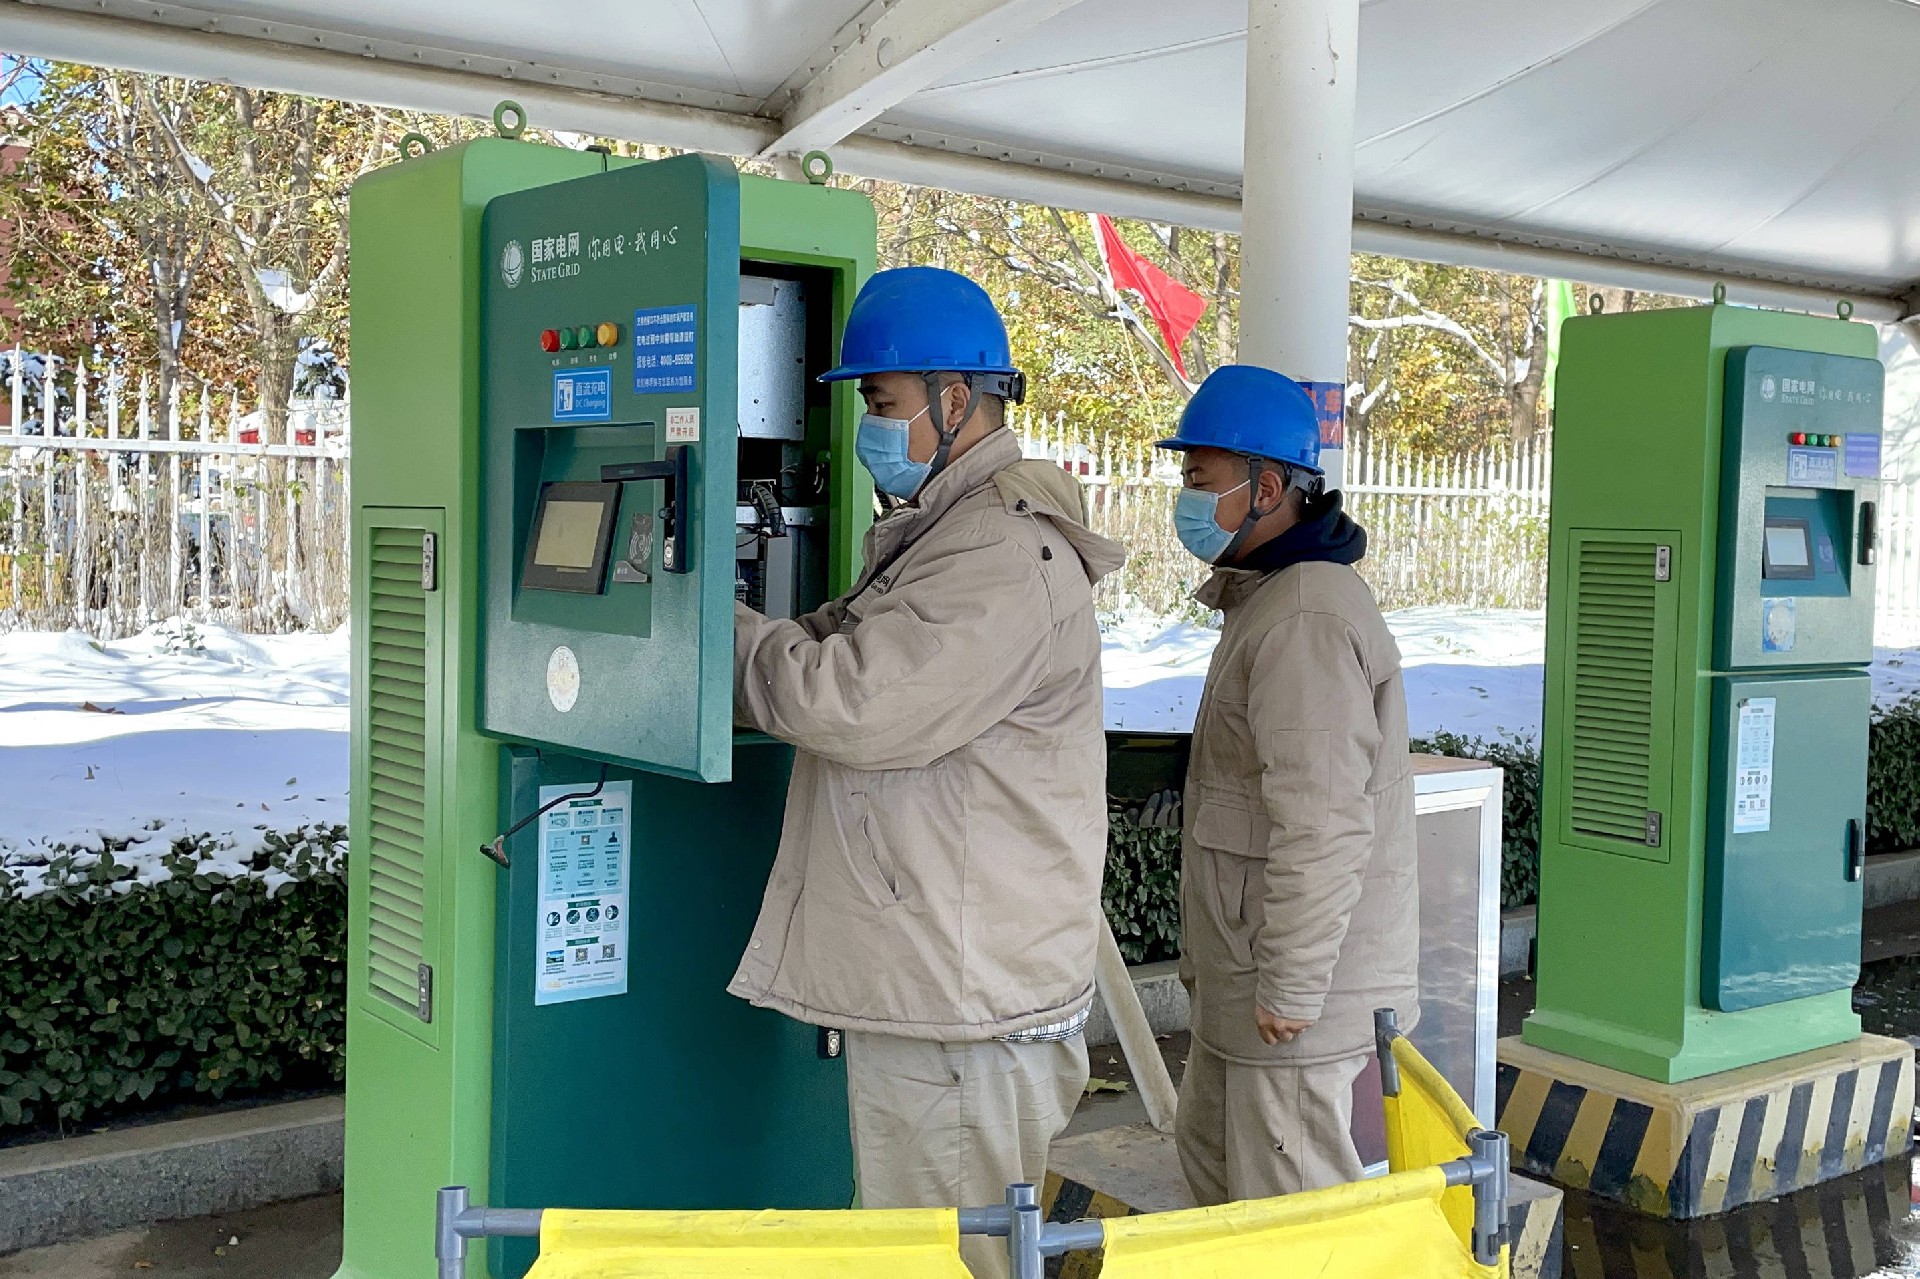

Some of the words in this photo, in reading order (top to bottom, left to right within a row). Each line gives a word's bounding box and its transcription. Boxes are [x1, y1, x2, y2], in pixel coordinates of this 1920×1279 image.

[531, 231, 580, 264] 国家电网
[531, 266, 557, 283] STATE
[558, 262, 580, 278] GRID
[575, 380, 606, 396] 直流充电
[1781, 377, 1816, 395] 国家电网
